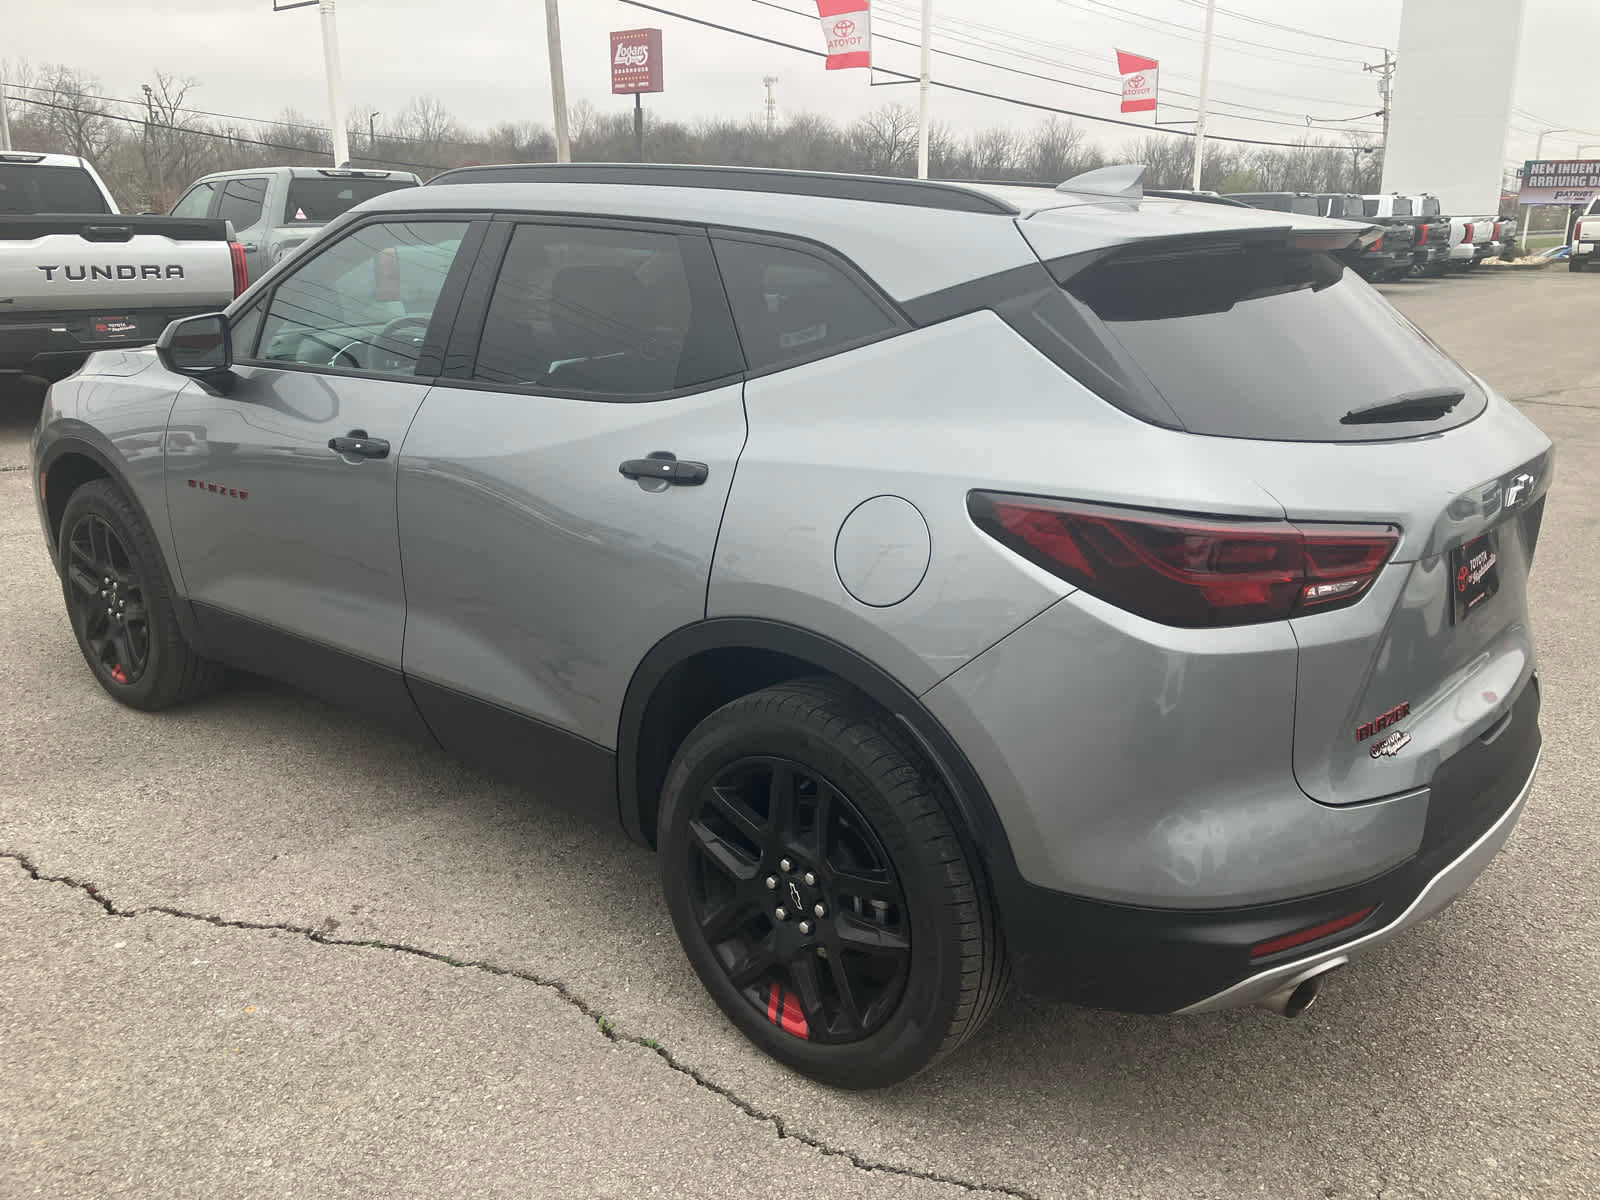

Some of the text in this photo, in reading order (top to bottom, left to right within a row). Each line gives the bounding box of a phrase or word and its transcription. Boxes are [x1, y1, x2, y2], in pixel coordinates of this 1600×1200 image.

[1530, 163, 1556, 174] NEW
[1528, 176, 1587, 187] ARRIVING
[36, 264, 185, 281] TUNDRA
[187, 478, 249, 501] BLAZER
[1356, 701, 1410, 742] BLAZER
